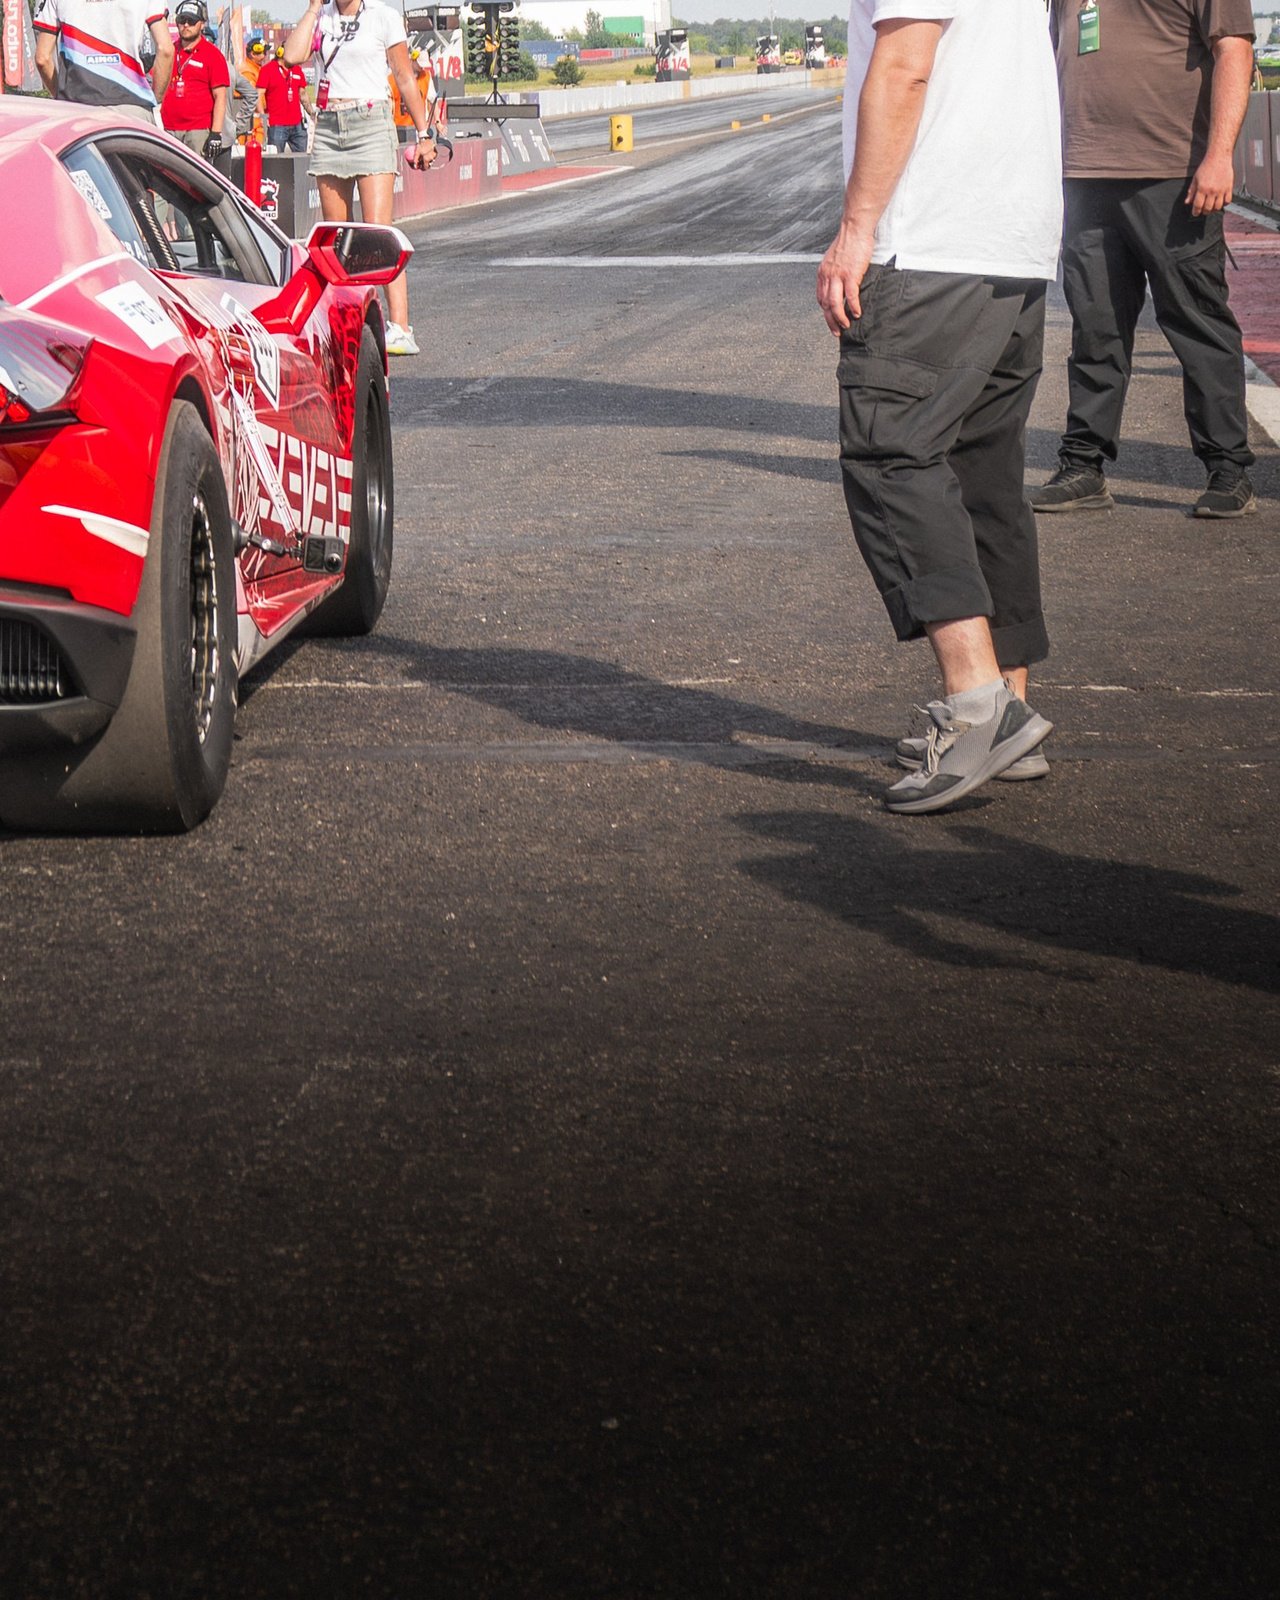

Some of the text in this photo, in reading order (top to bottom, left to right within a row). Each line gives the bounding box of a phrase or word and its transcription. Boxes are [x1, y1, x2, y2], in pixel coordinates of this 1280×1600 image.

[87, 55, 120, 64] AIMOL
[672, 56, 689, 72] 1/4
[436, 55, 462, 82] 1/8
